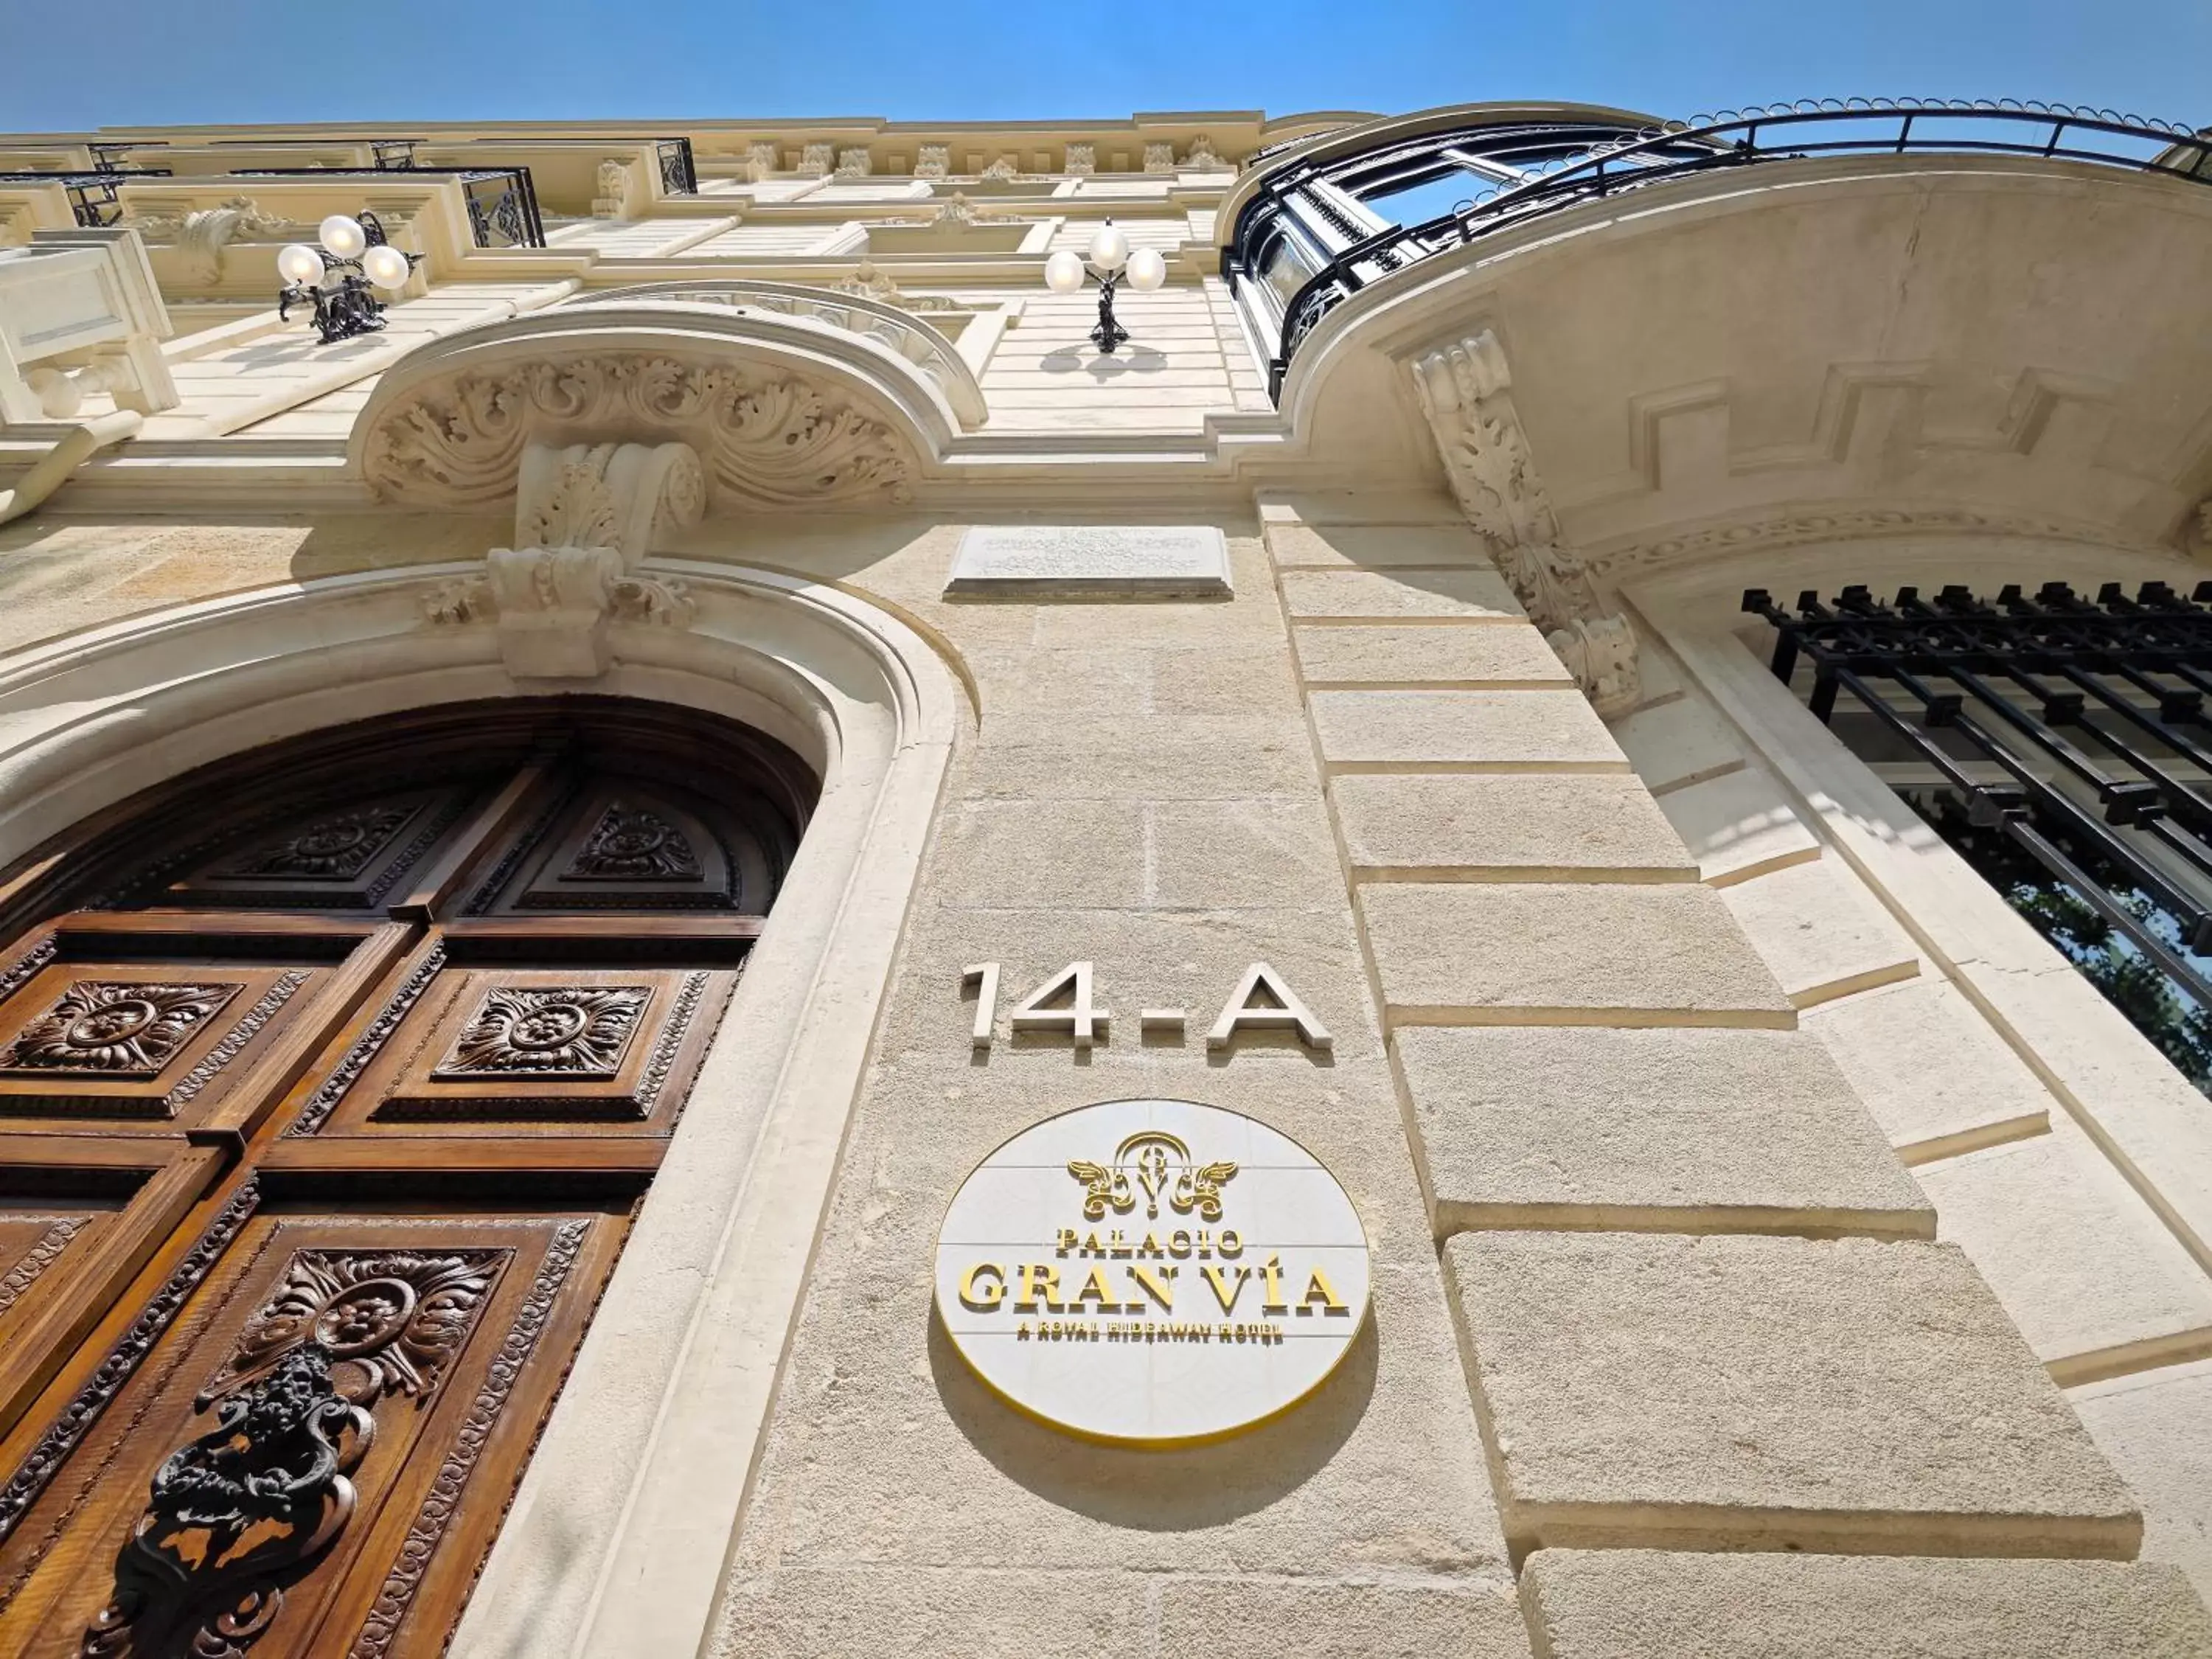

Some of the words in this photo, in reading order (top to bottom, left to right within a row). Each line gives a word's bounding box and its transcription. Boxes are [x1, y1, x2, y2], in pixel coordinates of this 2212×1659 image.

[961, 961, 1333, 1049] 14-A
[1056, 1228, 1244, 1258] PALACIO
[959, 1263, 1178, 1312] GRAN
[1200, 1252, 1349, 1317] VÍA
[1037, 1321, 1099, 1342] ROYAL
[1107, 1322, 1211, 1344] HIDEAWAY
[1219, 1324, 1284, 1345] HOTEL
